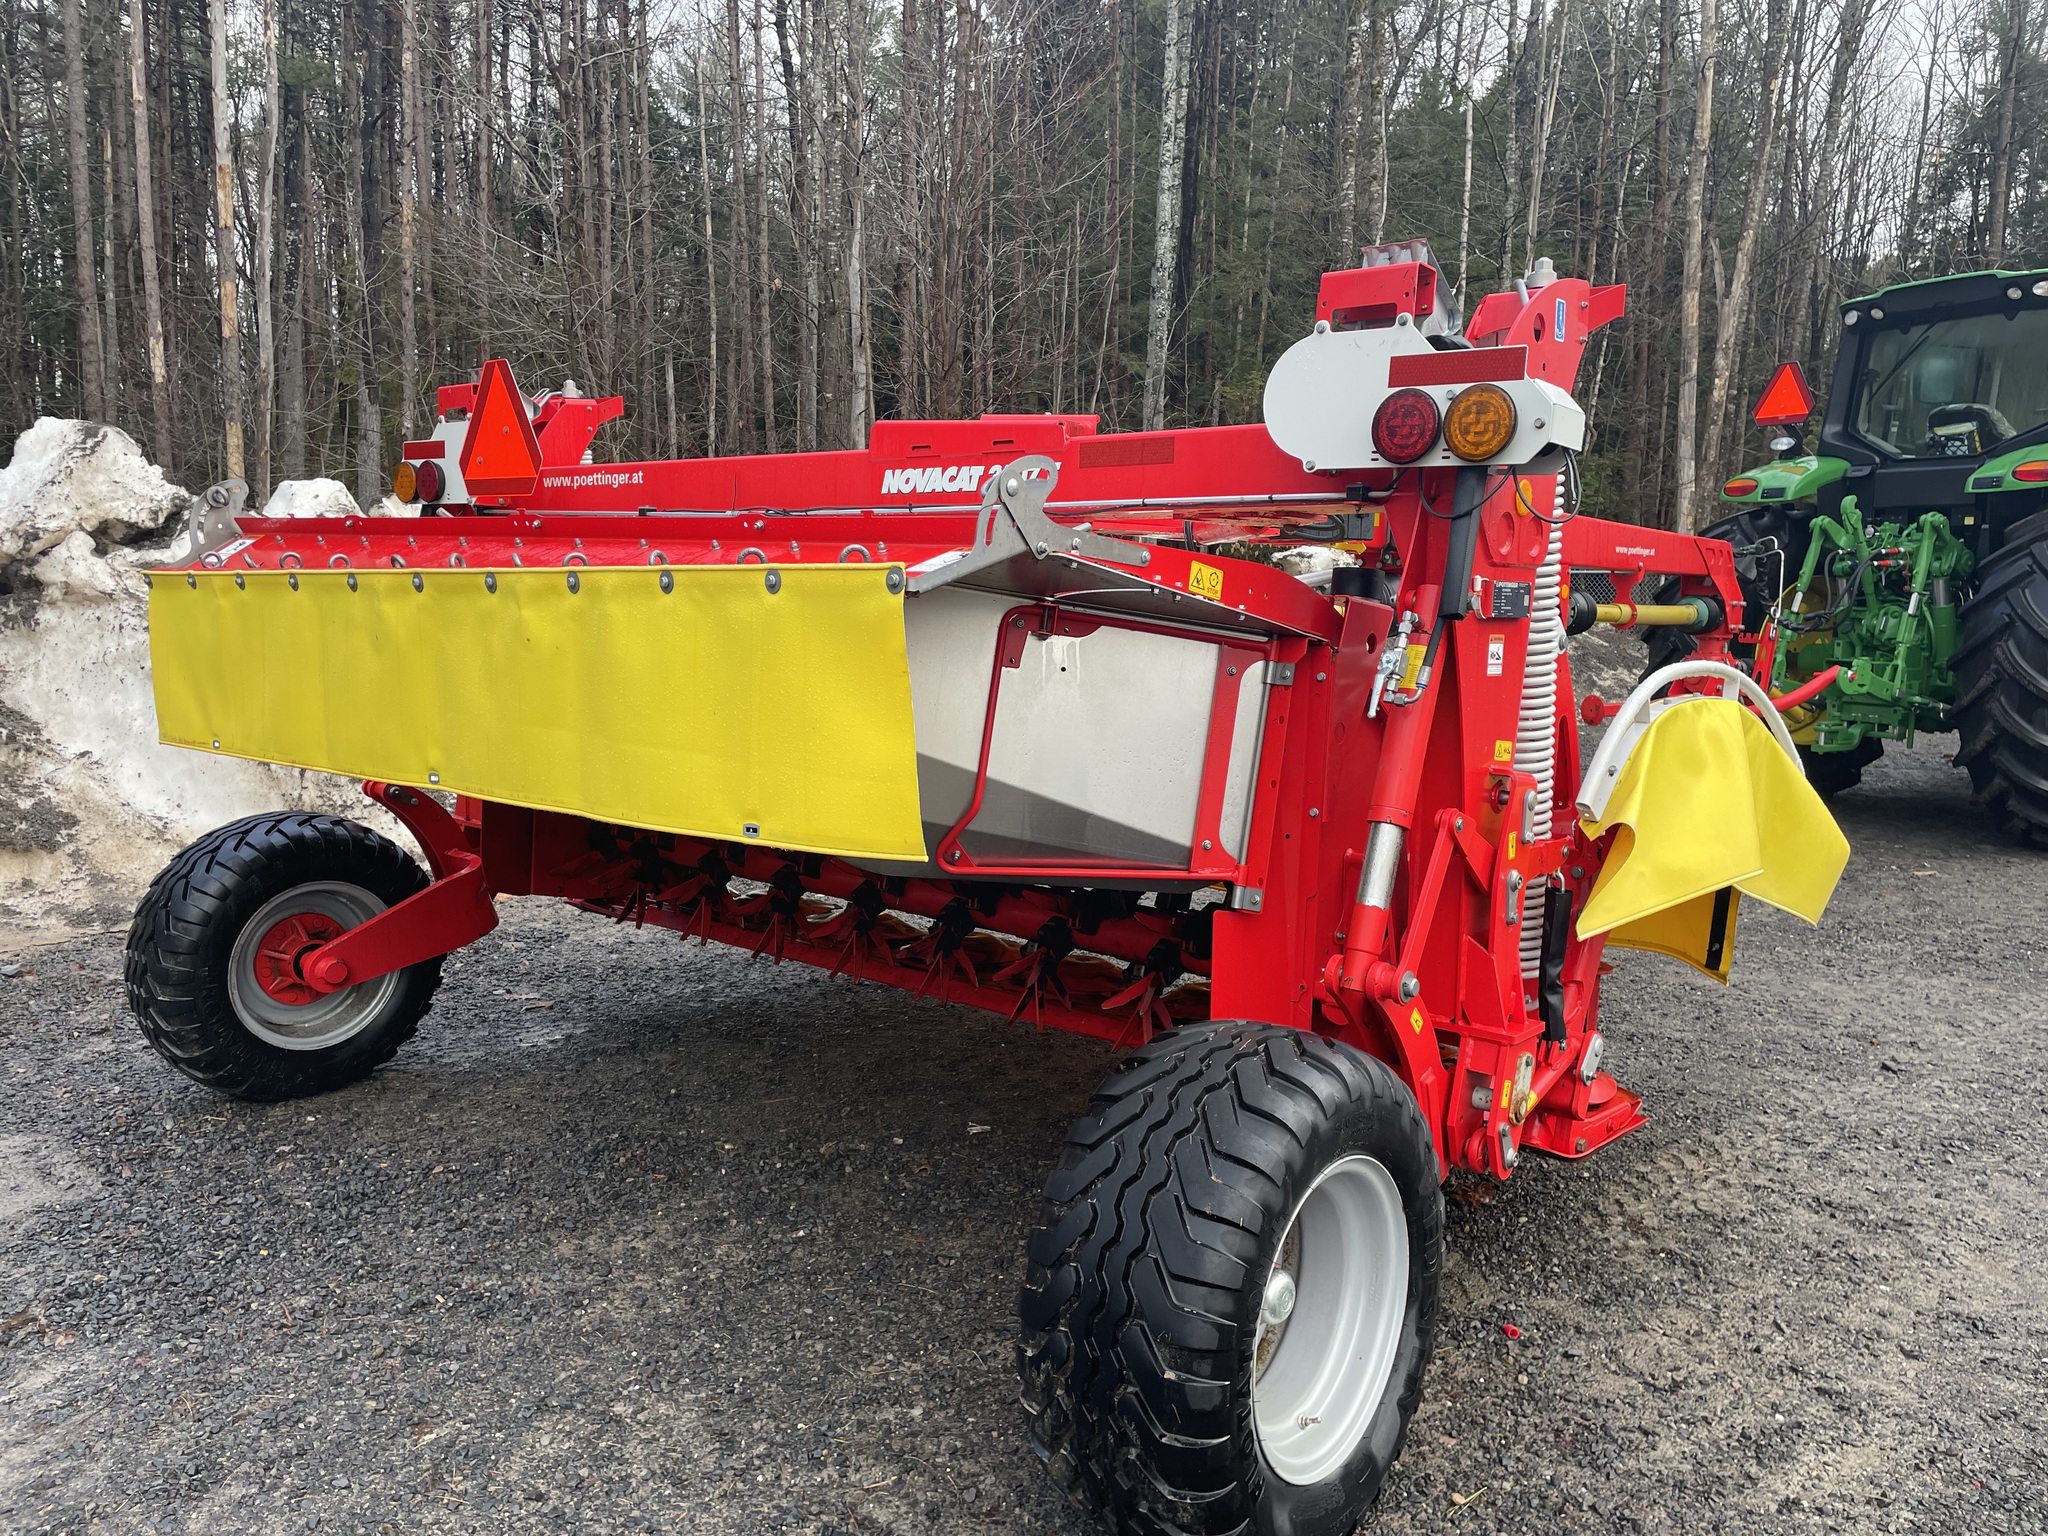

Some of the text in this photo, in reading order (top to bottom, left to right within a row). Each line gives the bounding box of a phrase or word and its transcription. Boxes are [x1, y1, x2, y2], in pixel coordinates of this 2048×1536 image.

[543, 470, 644, 490] www.poettinger.at
[880, 465, 985, 494] NOVACAT
[1615, 546, 1655, 557] www.poettinger.at
[1206, 587, 1219, 596] STOP
